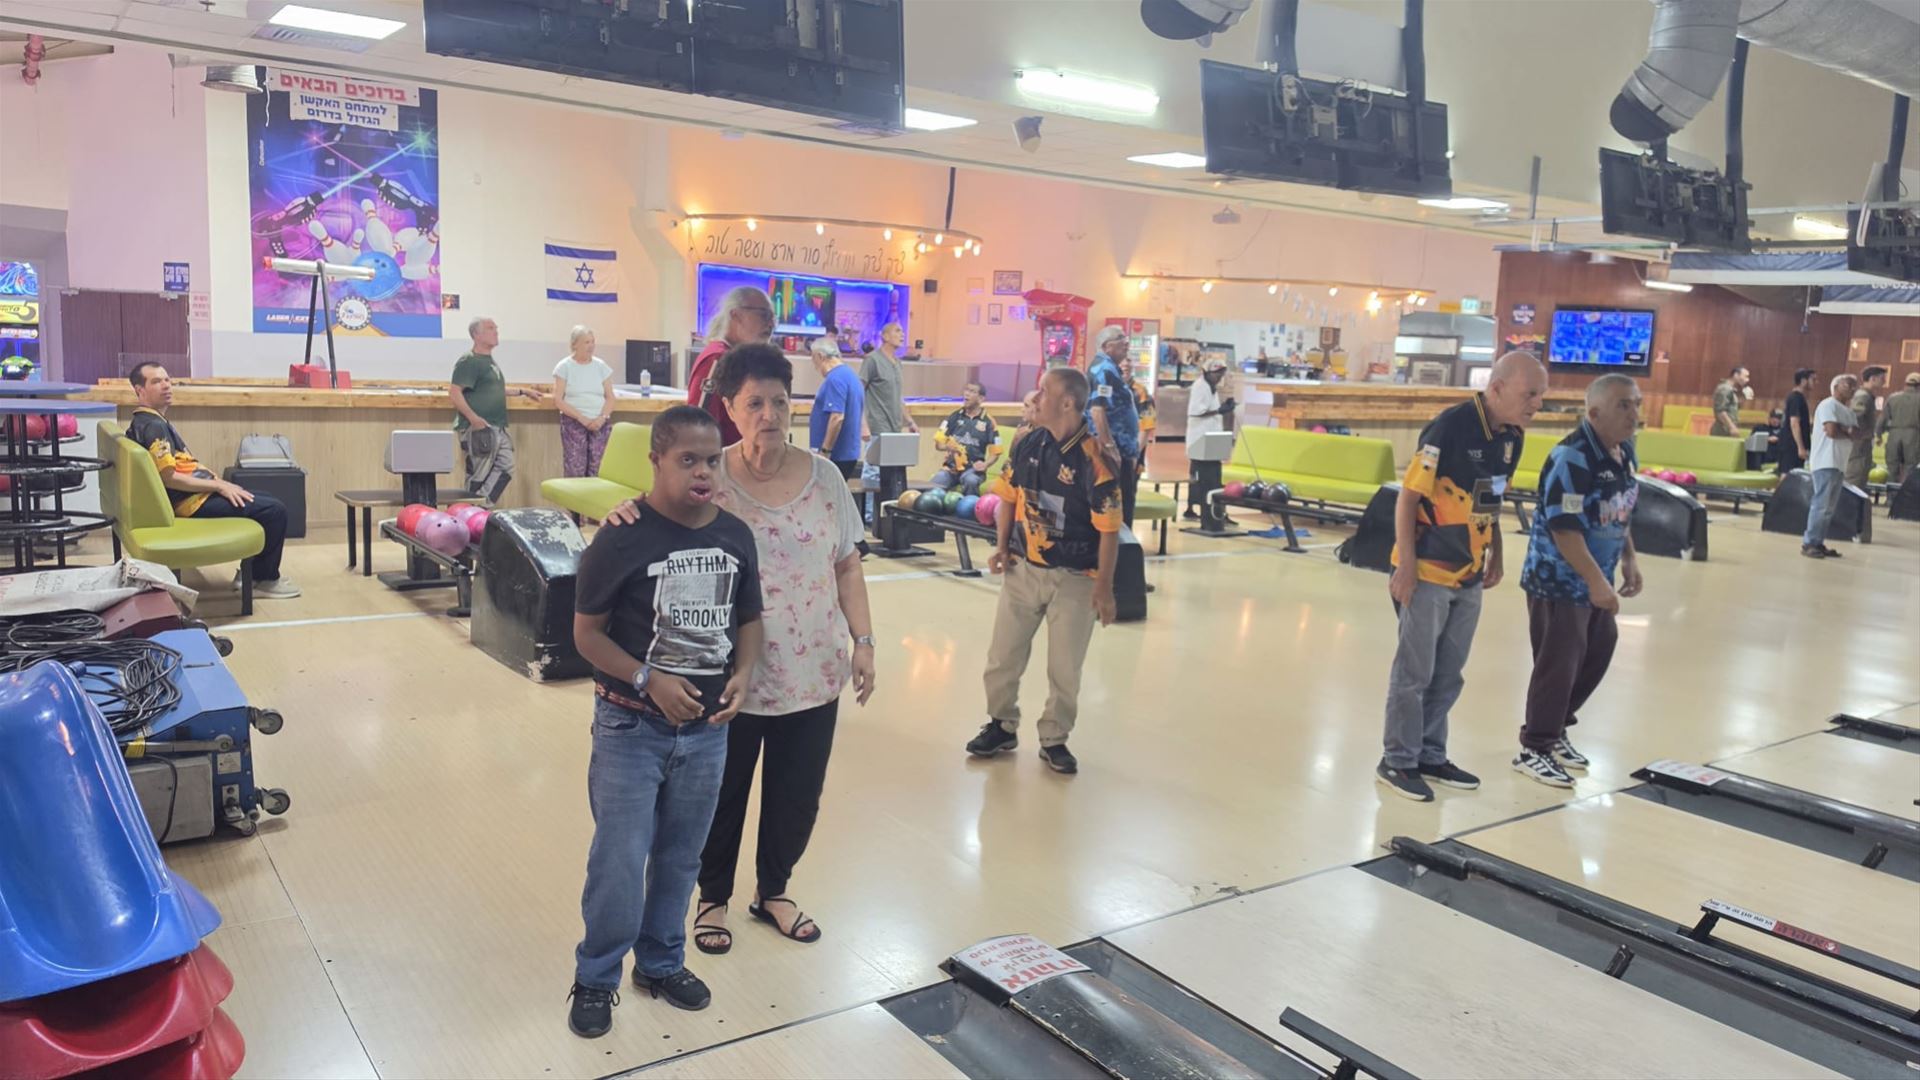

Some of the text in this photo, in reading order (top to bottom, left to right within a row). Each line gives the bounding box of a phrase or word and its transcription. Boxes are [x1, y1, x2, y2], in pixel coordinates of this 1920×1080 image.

[280, 73, 406, 101] ברוכים הבאים
[299, 94, 387, 115] למתחם האקשן
[307, 108, 380, 125] הגדול בדרום
[735, 238, 765, 259] ועשה
[771, 242, 795, 263] מרע
[802, 246, 820, 265] סור
[667, 554, 728, 575] RHYTHM
[672, 607, 729, 628] BROOKLY
[1000, 959, 1083, 989] אזהרה
